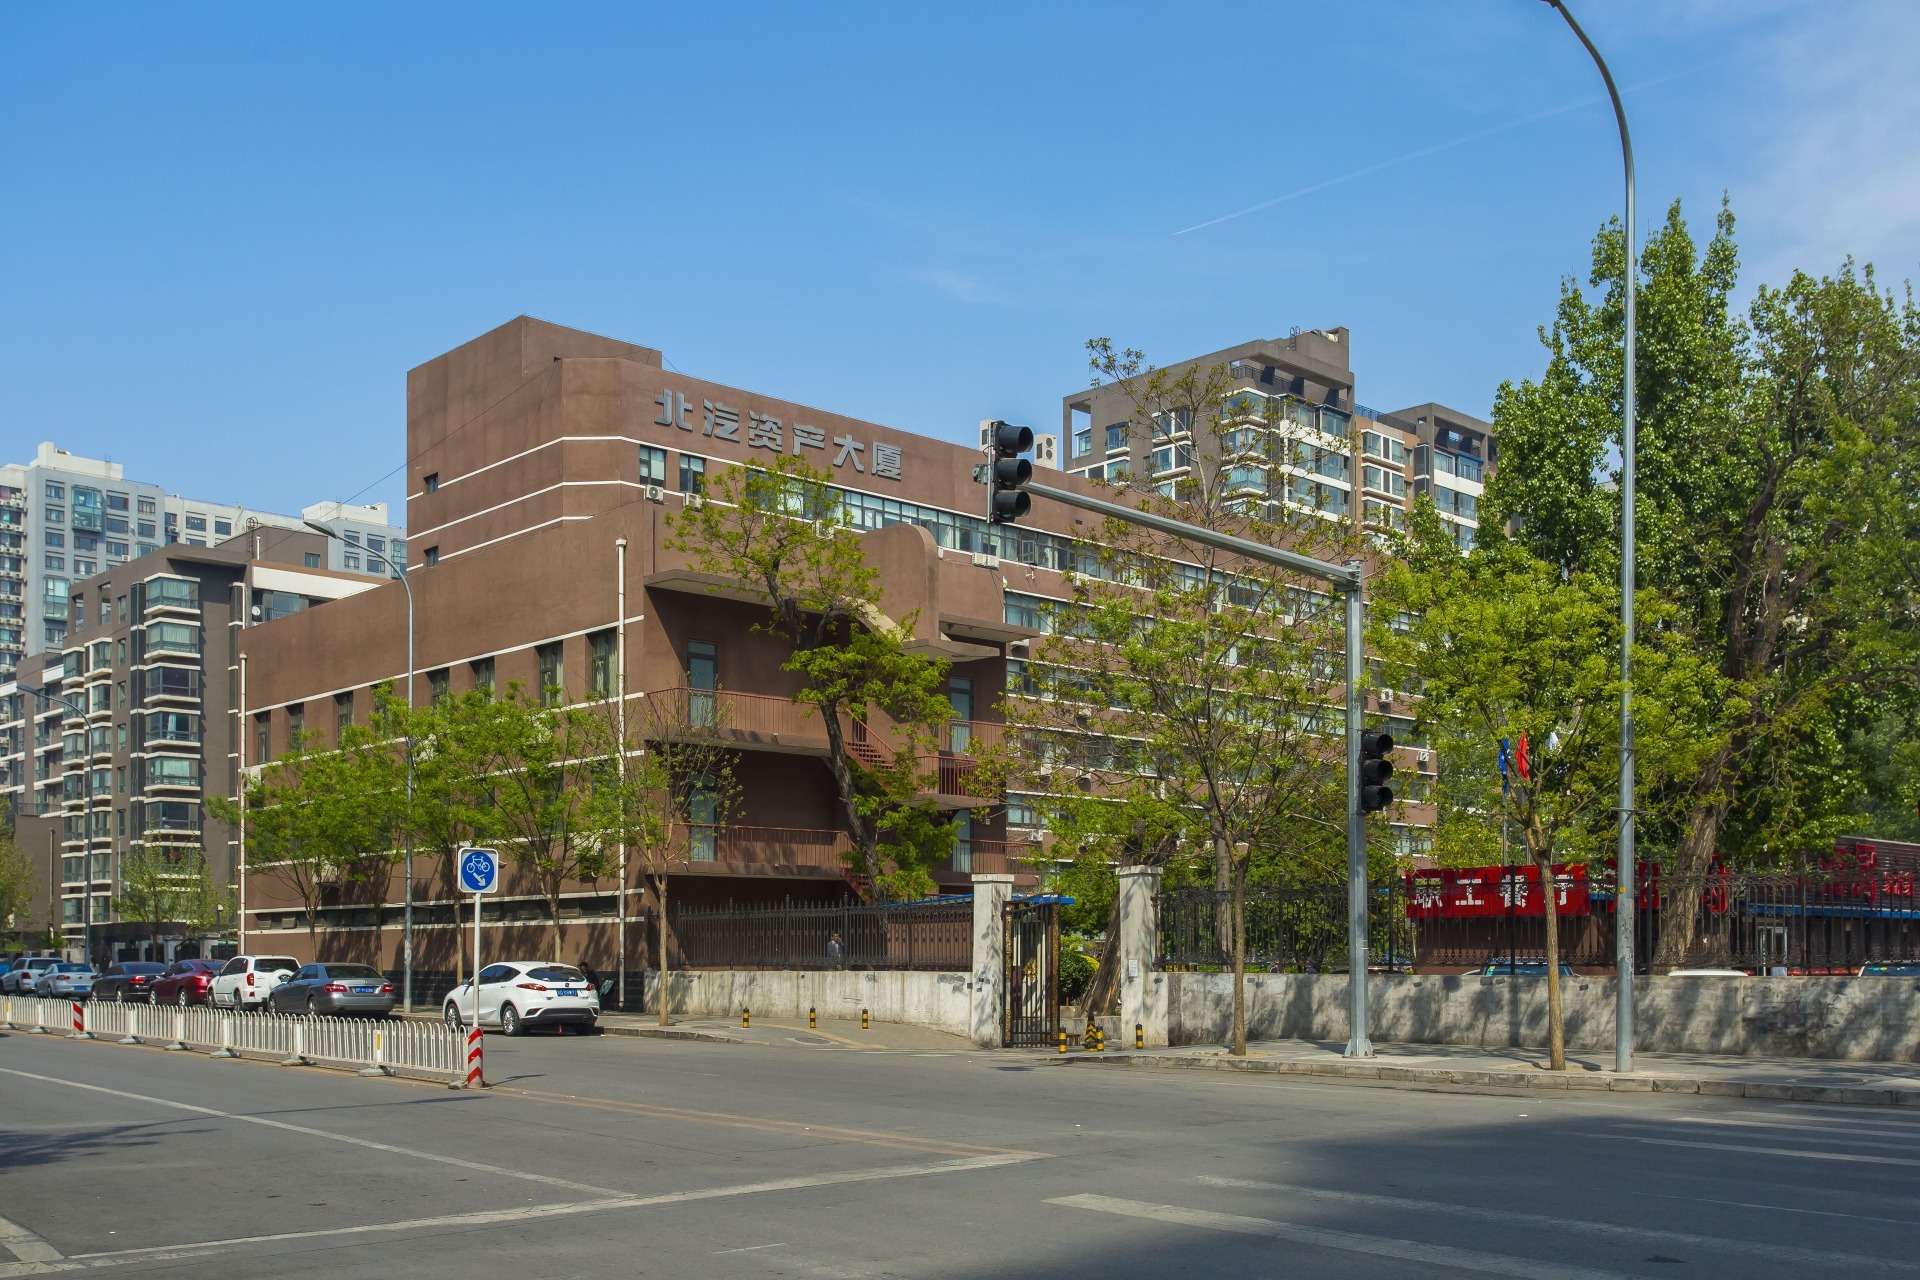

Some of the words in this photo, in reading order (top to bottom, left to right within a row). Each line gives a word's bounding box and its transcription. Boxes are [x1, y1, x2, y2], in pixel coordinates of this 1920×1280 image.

[654, 388, 902, 482] 北汽资产大厦
